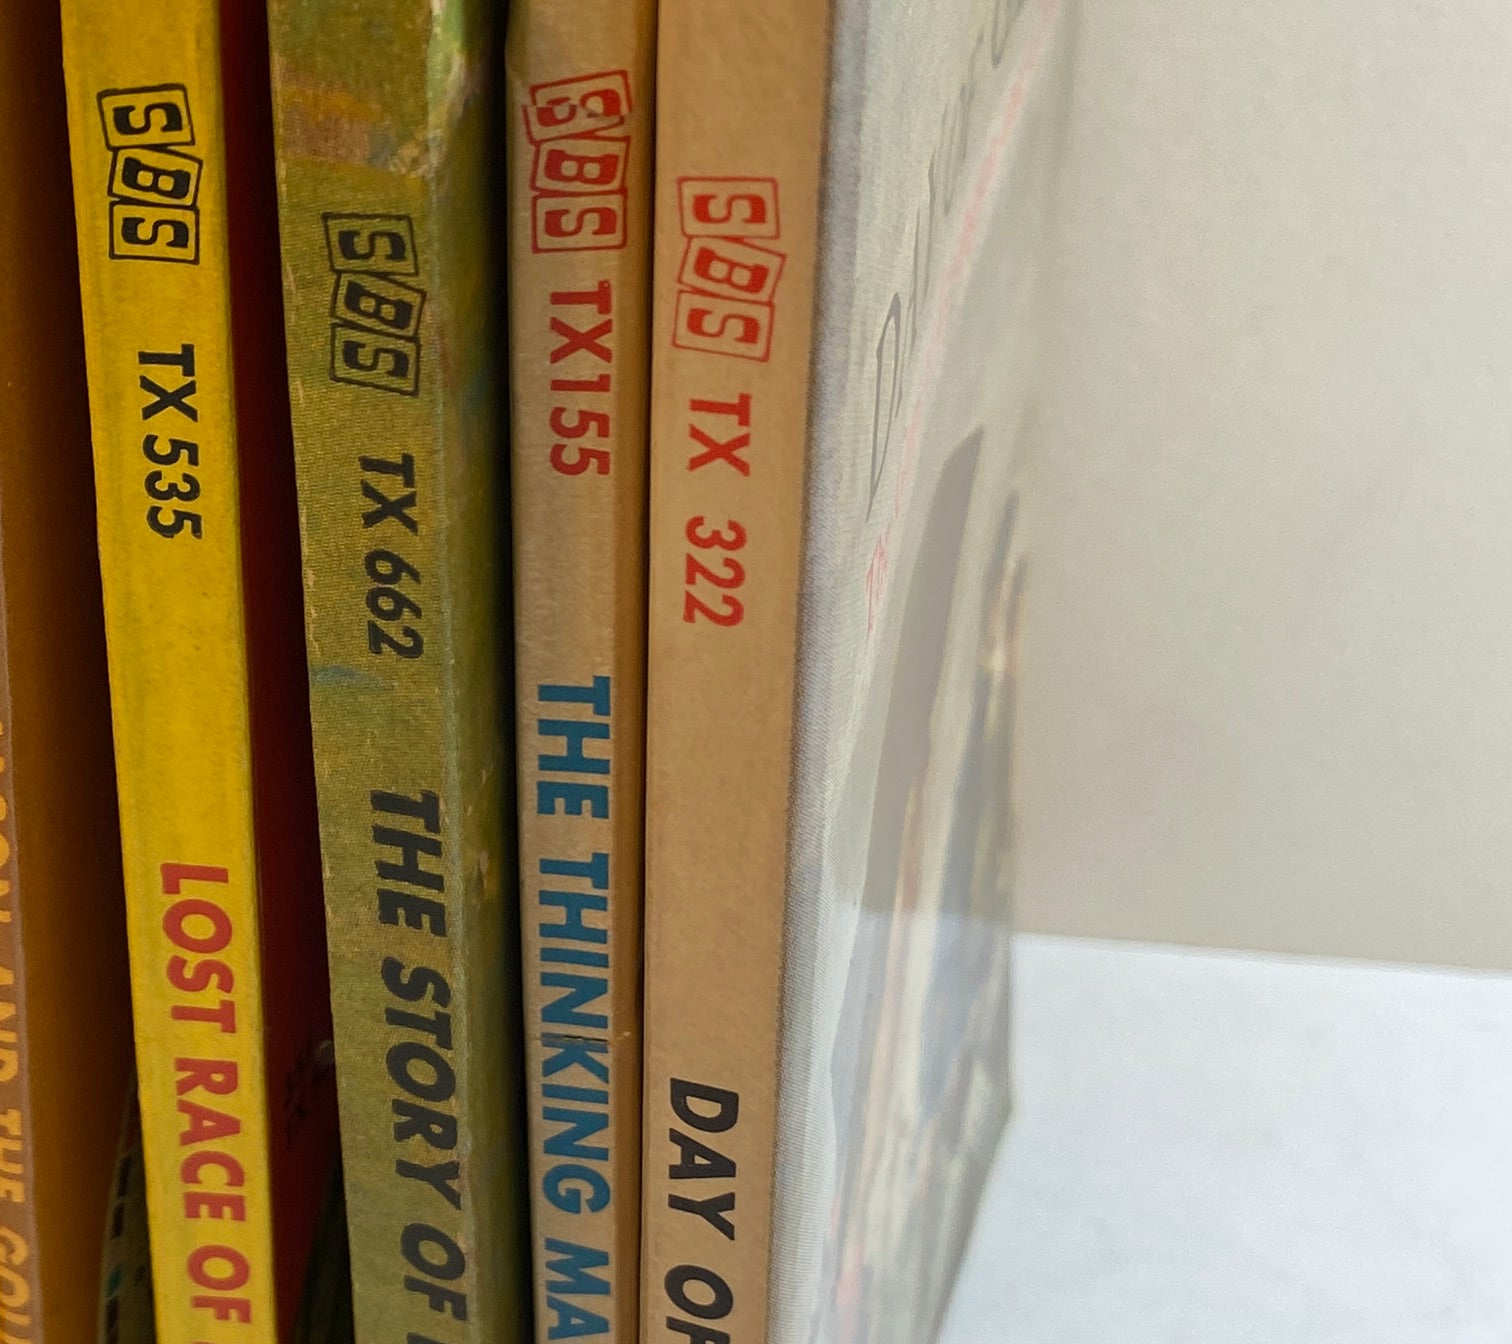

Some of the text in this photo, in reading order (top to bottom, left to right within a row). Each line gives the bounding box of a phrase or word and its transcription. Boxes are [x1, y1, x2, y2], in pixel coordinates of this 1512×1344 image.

[137, 344, 198, 422] TX
[687, 392, 752, 477] TX
[142, 434, 202, 540] 535
[358, 452, 418, 535] TX
[364, 550, 424, 660] 662
[683, 515, 746, 627] 322
[537, 675, 611, 821] THE
[370, 788, 447, 939] THE
[159, 862, 236, 1035] LOST
[381, 957, 463, 1211] STORY
[538, 852, 611, 1214] THINKING
[174, 1057, 247, 1224] RACE
[668, 1077, 739, 1240] DAY
[188, 1243, 251, 1325] OF
[400, 1223, 467, 1321] OF
